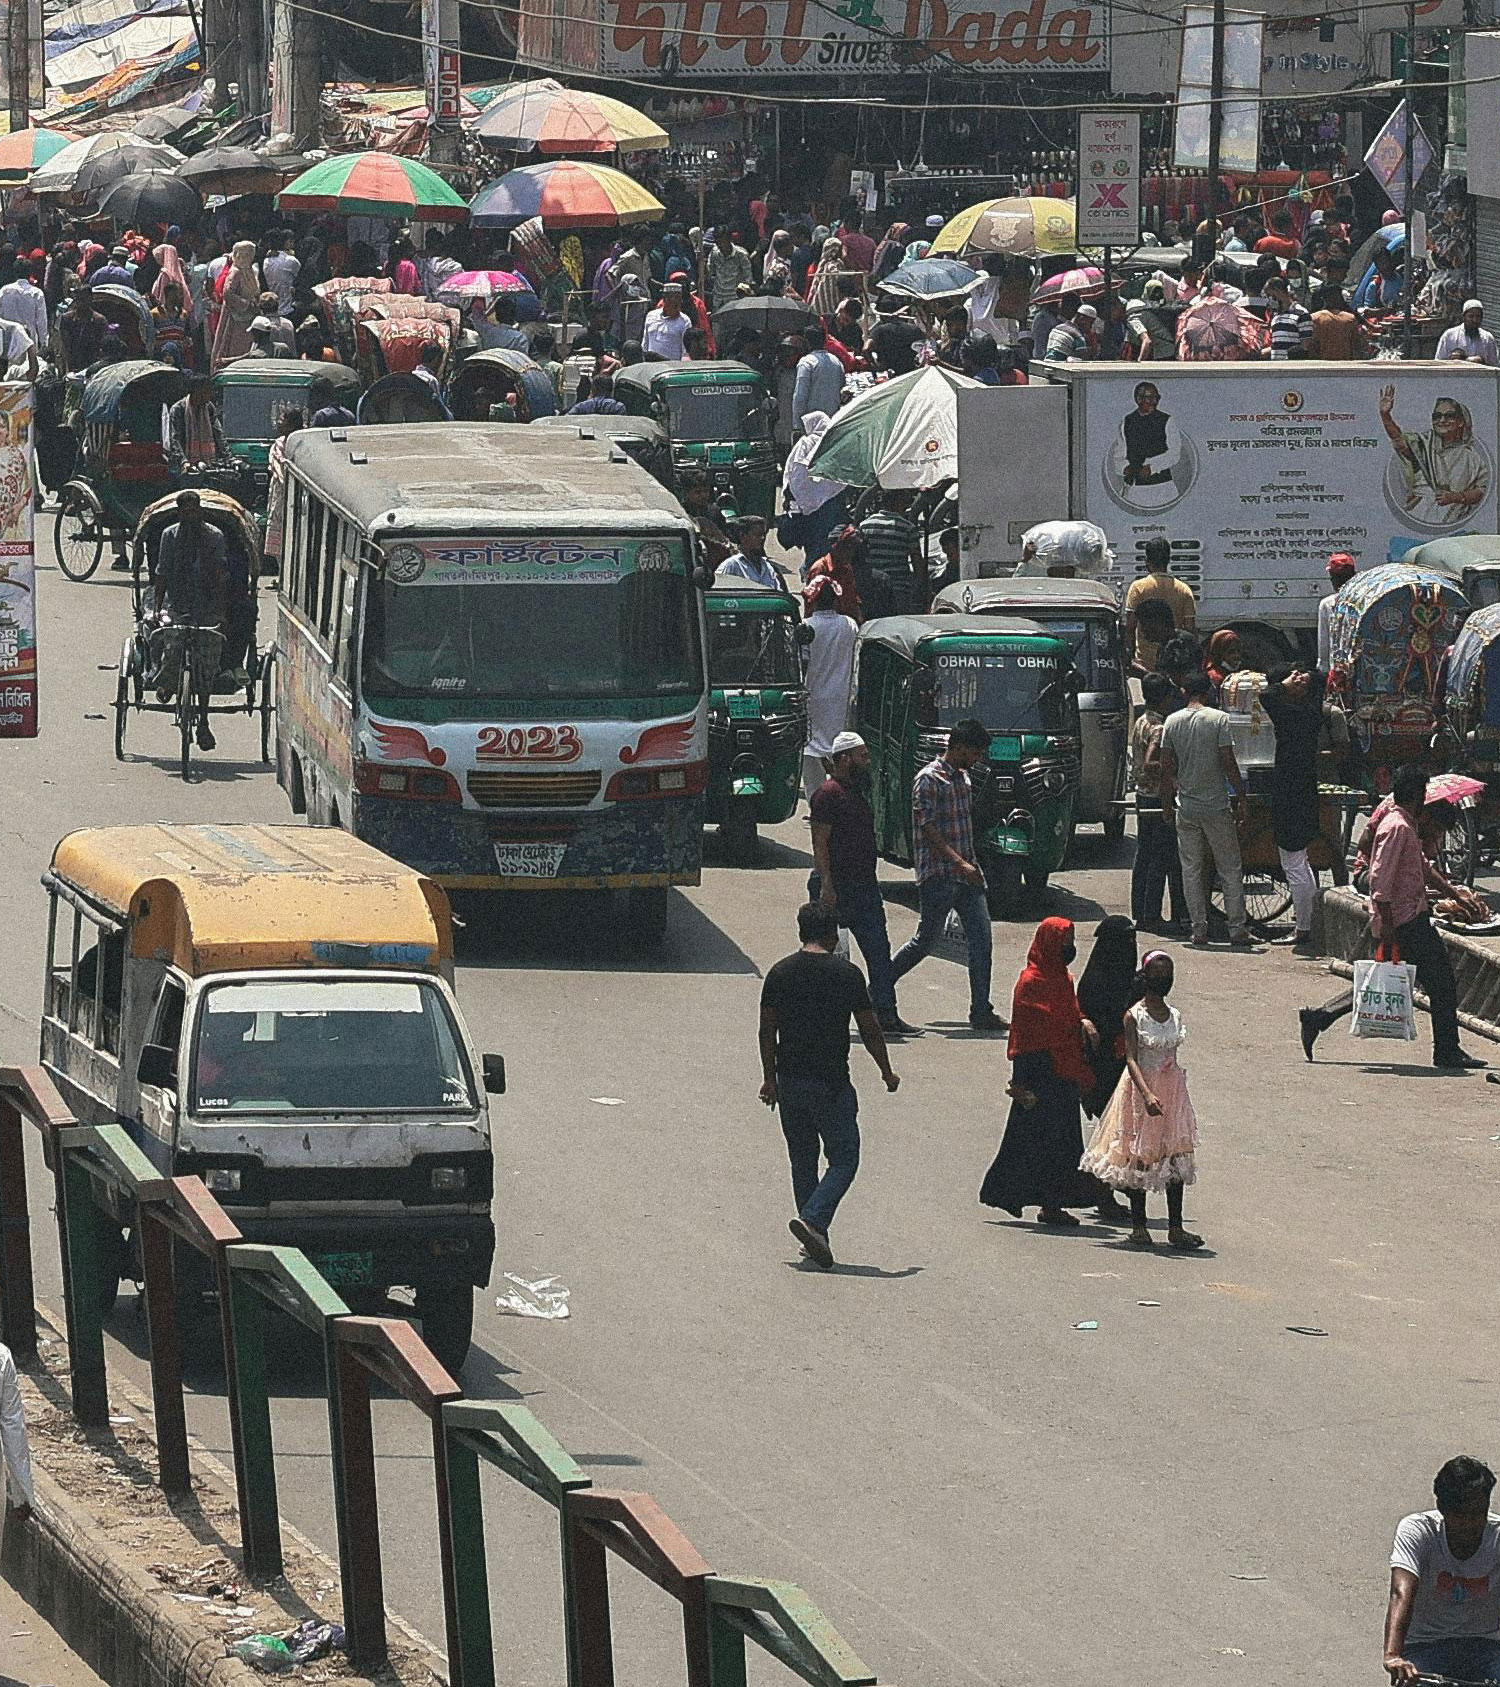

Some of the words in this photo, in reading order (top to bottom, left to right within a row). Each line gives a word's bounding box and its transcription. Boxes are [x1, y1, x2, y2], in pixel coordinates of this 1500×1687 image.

[1260, 424, 1285, 436] পবিত্র
[1286, 426, 1322, 436] রমজানে
[1304, 437, 1321, 448] ডিম
[938, 656, 981, 668] OBHAI
[1017, 657, 1058, 669] OBHAI
[5, 687, 31, 708] নিখিল
[476, 725, 584, 763] 2023
[200, 1095, 229, 1107] Lucas
